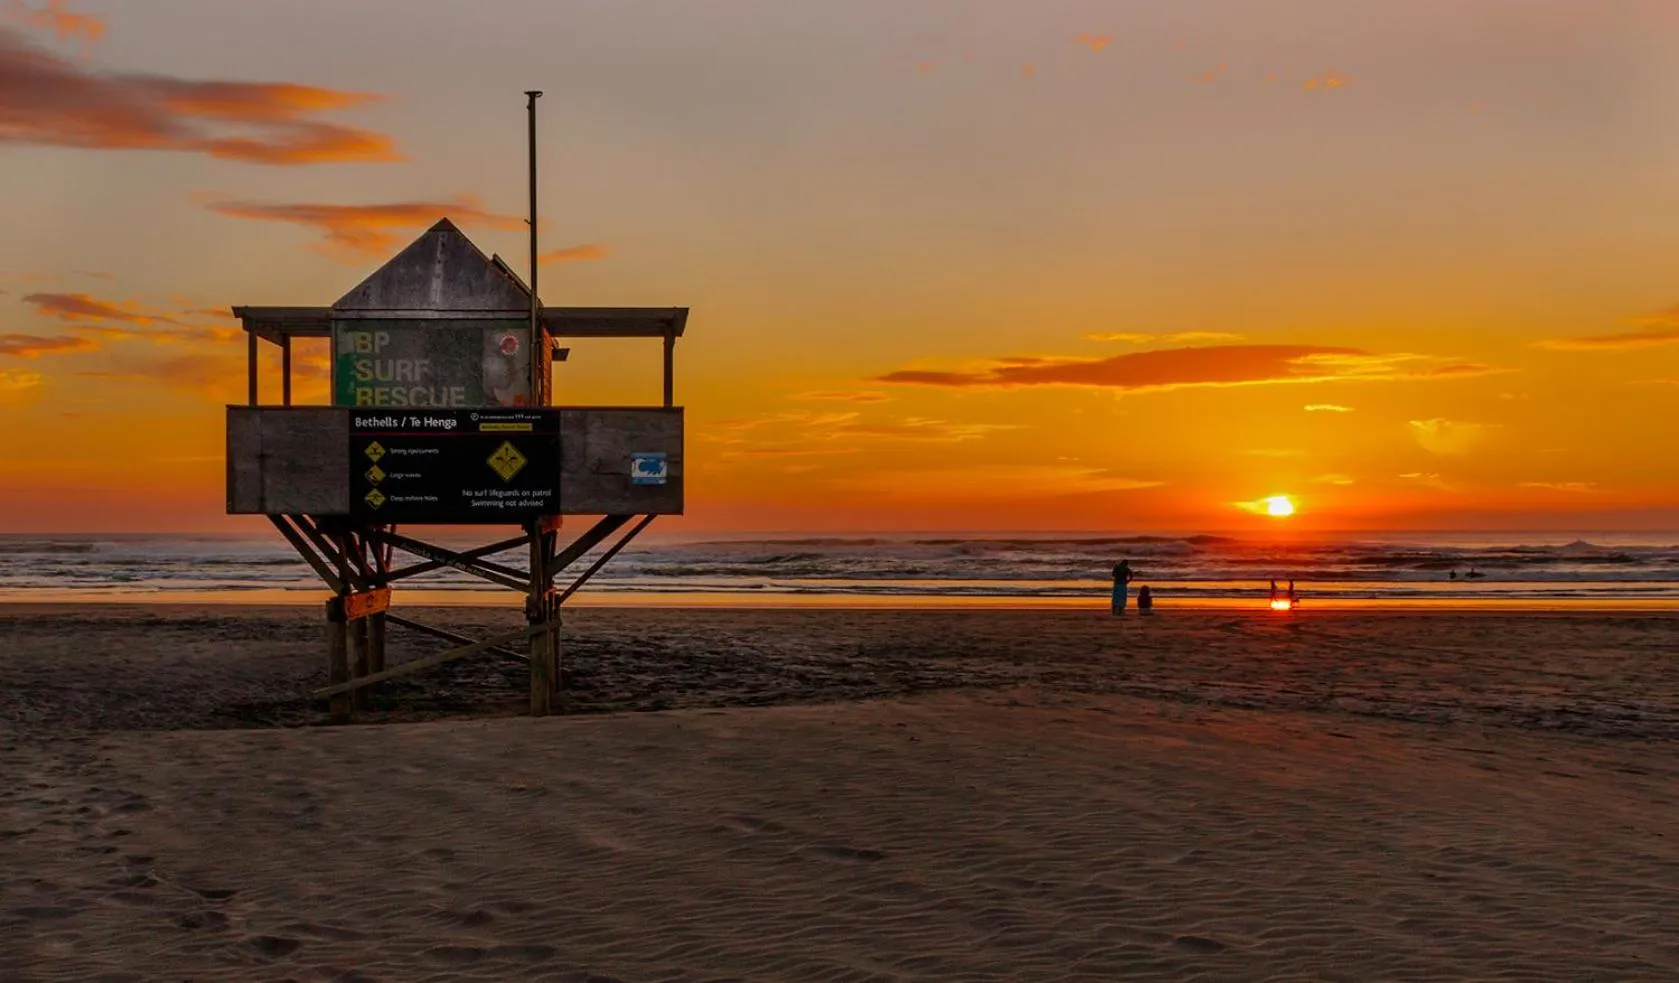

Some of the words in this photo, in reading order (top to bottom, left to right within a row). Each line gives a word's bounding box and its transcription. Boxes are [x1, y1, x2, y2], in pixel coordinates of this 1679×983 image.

[355, 331, 390, 354] BP
[355, 359, 430, 382] SURF
[355, 386, 466, 408] RESCUE
[355, 416, 399, 428] Bethells
[409, 416, 422, 428] Te
[424, 416, 458, 430] Henga
[462, 488, 473, 496] No
[474, 488, 488, 496] surf
[489, 488, 520, 497] lifeguards
[532, 488, 551, 497] patrol
[471, 499, 504, 508] Swimming
[505, 499, 517, 507] not
[518, 499, 544, 507] advised
